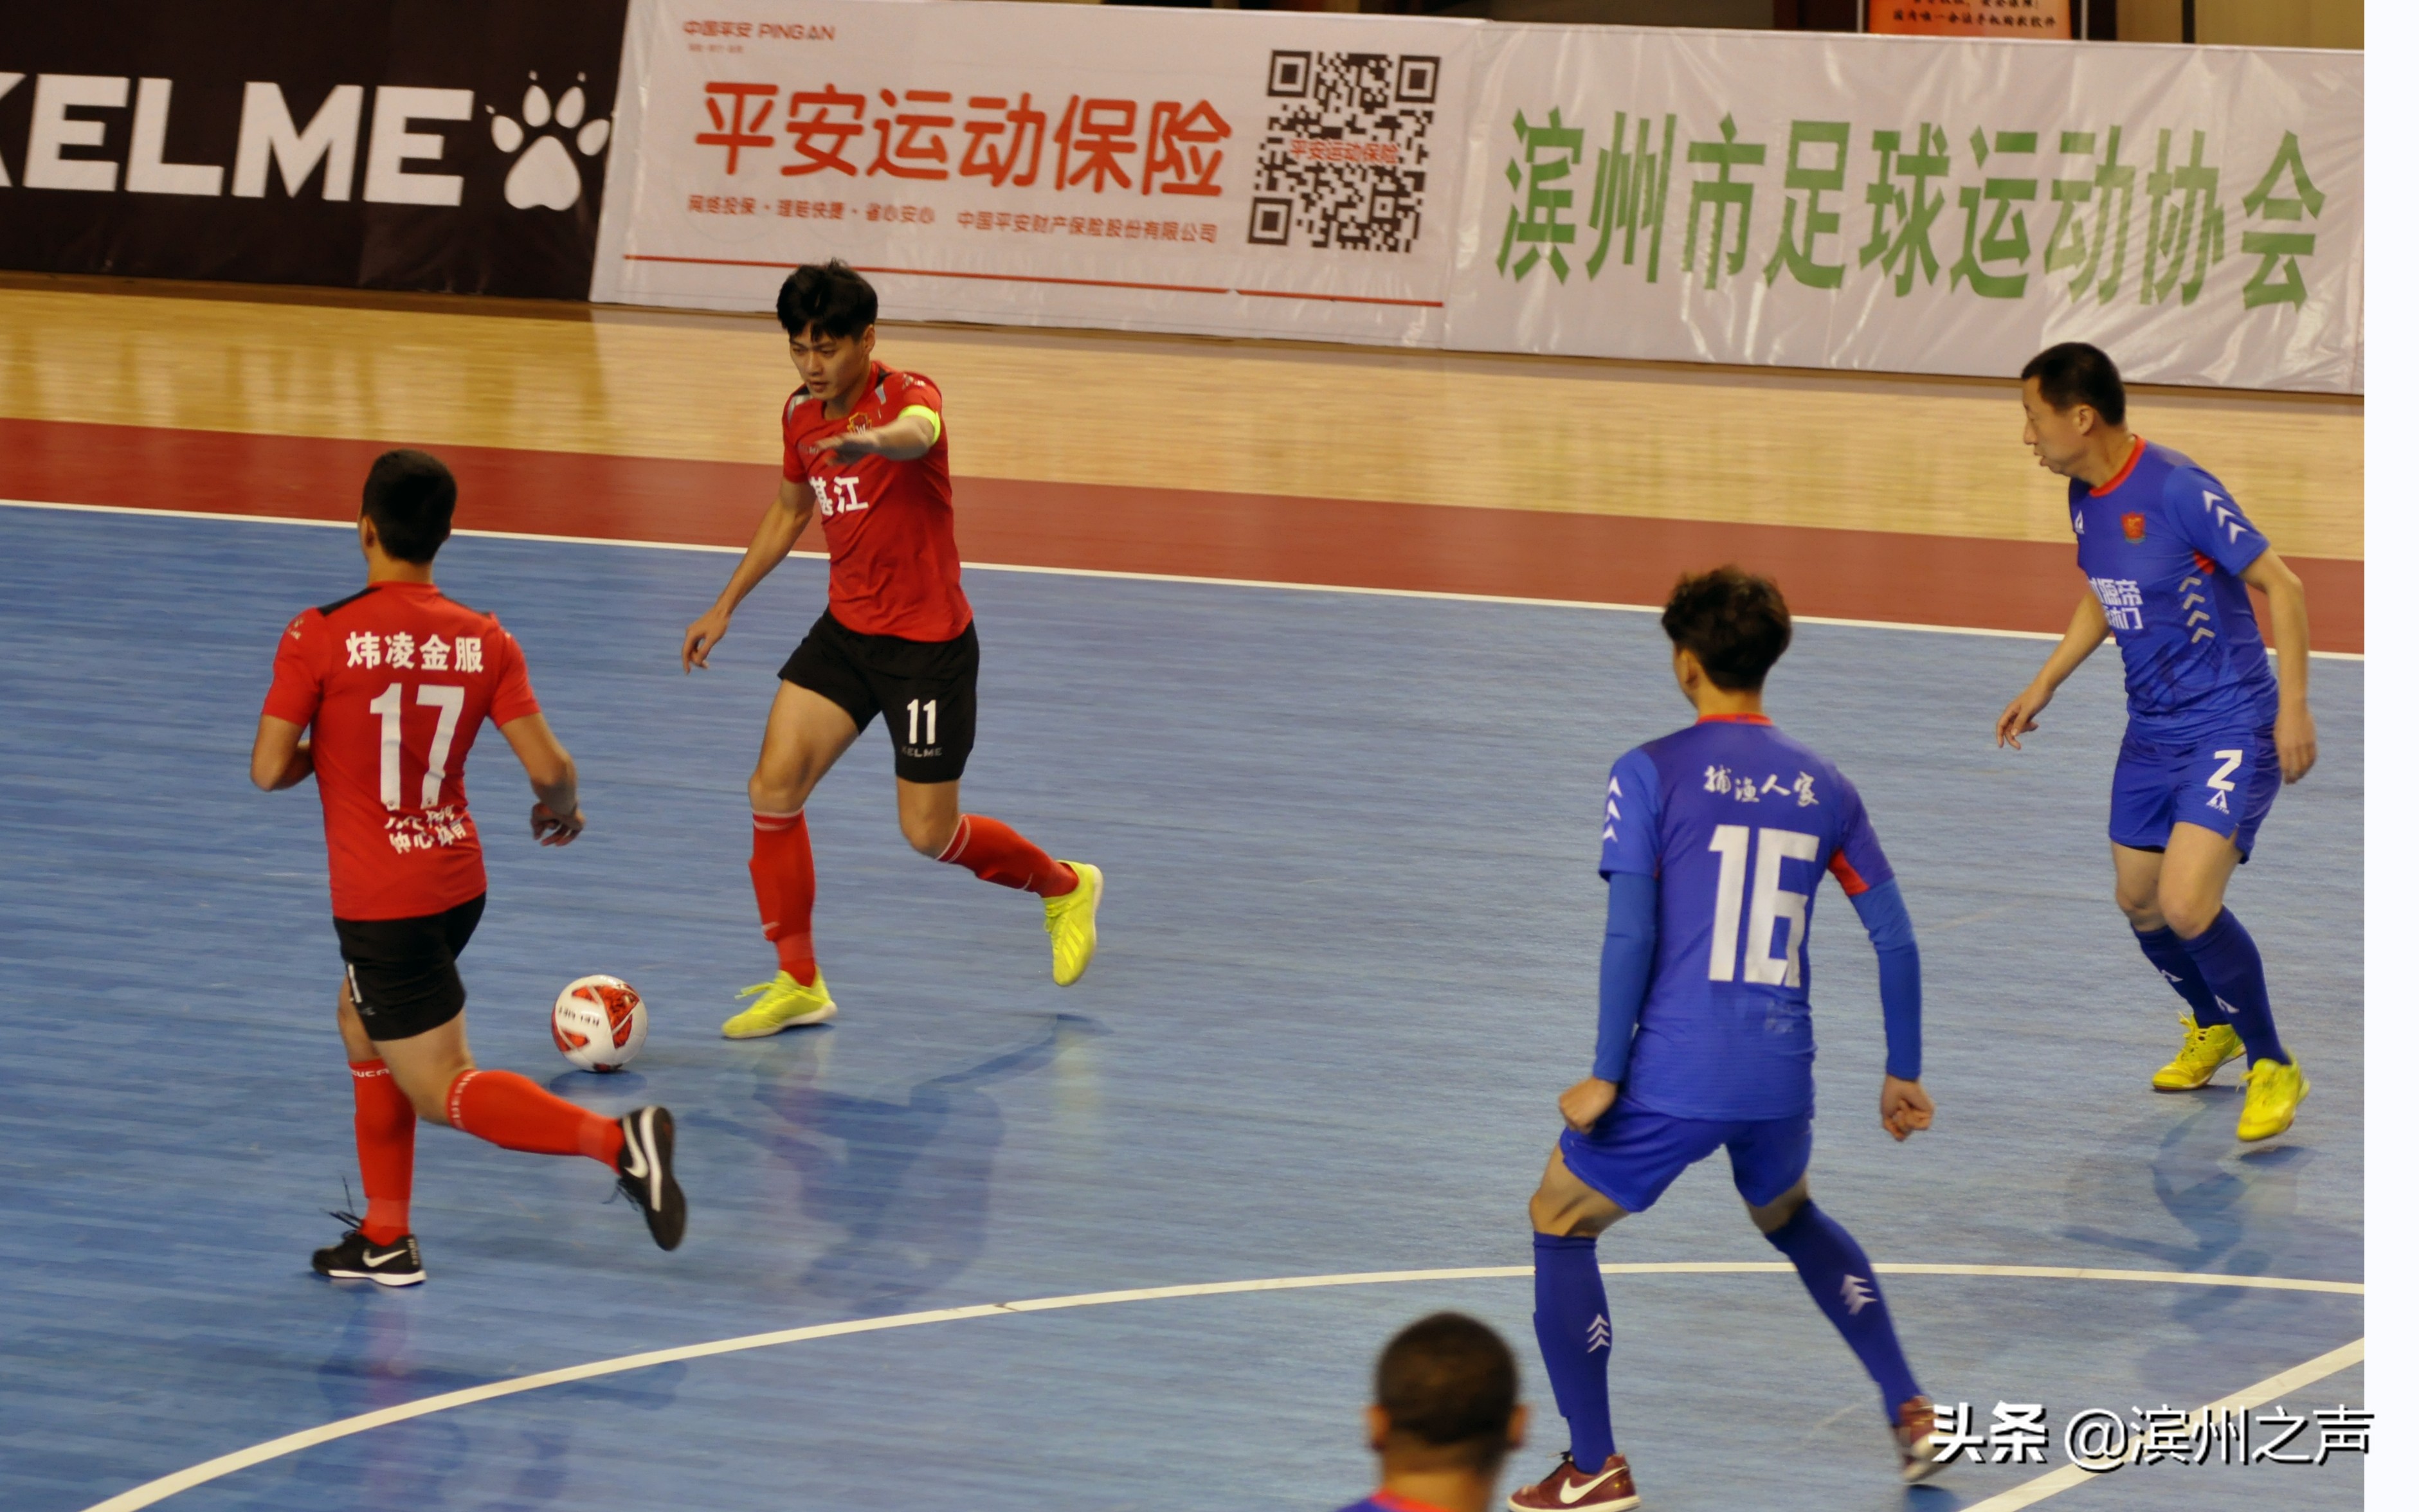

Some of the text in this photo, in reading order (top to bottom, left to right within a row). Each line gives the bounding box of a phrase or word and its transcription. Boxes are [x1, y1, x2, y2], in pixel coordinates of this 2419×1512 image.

[684, 21, 752, 38] 中国平安
[0, 73, 474, 206] ELME
[694, 82, 1233, 197] 平安运动保险
[1290, 138, 1400, 165] 平安运动保险
[957, 210, 1218, 244] 中国平安财产保险股份有限公司
[1494, 106, 2326, 313] 滨州市足球运动协会
[345, 631, 484, 673] 炜凌金服
[907, 699, 936, 744] 11
[370, 682, 465, 811] 17
[2206, 749, 2243, 791] 2
[1708, 824, 1820, 988] 16
